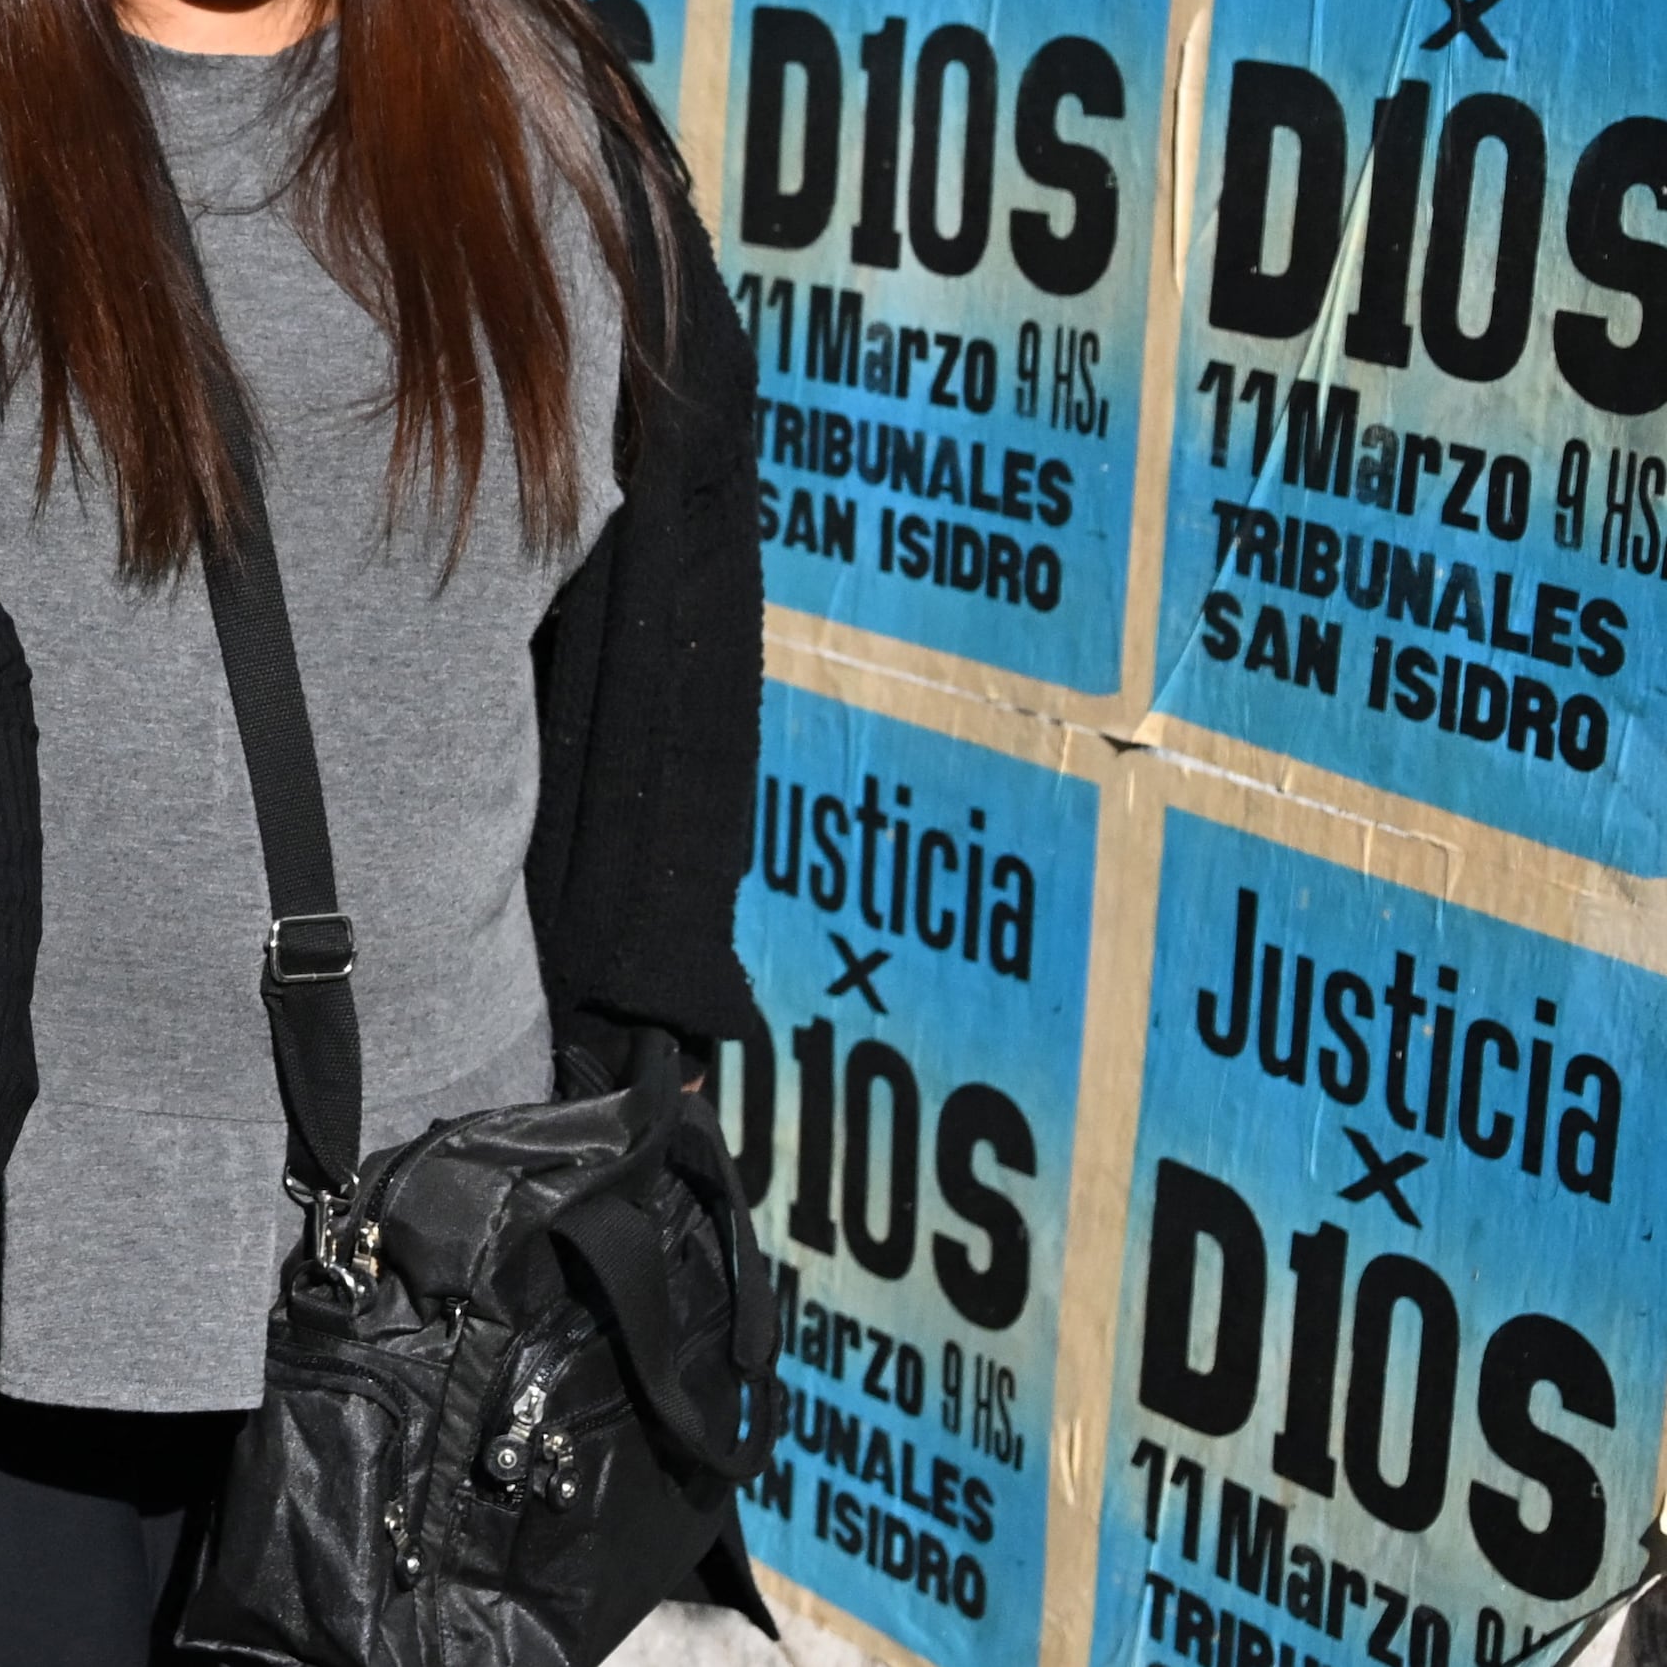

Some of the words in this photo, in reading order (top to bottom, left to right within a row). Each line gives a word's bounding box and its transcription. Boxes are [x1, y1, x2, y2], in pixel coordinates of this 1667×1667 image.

[736, 273, 794, 373] 11
[806, 285, 998, 415] Marzo
[1016, 319, 1041, 418] 9
[1198, 360, 1279, 477] 11
[1282, 377, 1532, 542] Marzo
[1554, 437, 1591, 551] 9
[879, 508, 1062, 613] ISIDRO
[1212, 500, 1628, 678] TRIBUNALES
[1202, 591, 1342, 696] SAN
[1368, 636, 1609, 773] ISIDRO
[761, 774, 1036, 982] usticia
[1197, 887, 1622, 1204] Justicia
[775, 1382, 994, 1544] UNALES
[942, 1339, 964, 1435] 9
[815, 1477, 987, 1621] ISIDRO
[1131, 1437, 1205, 1563] 11
[1215, 1477, 1452, 1667] Marzo
